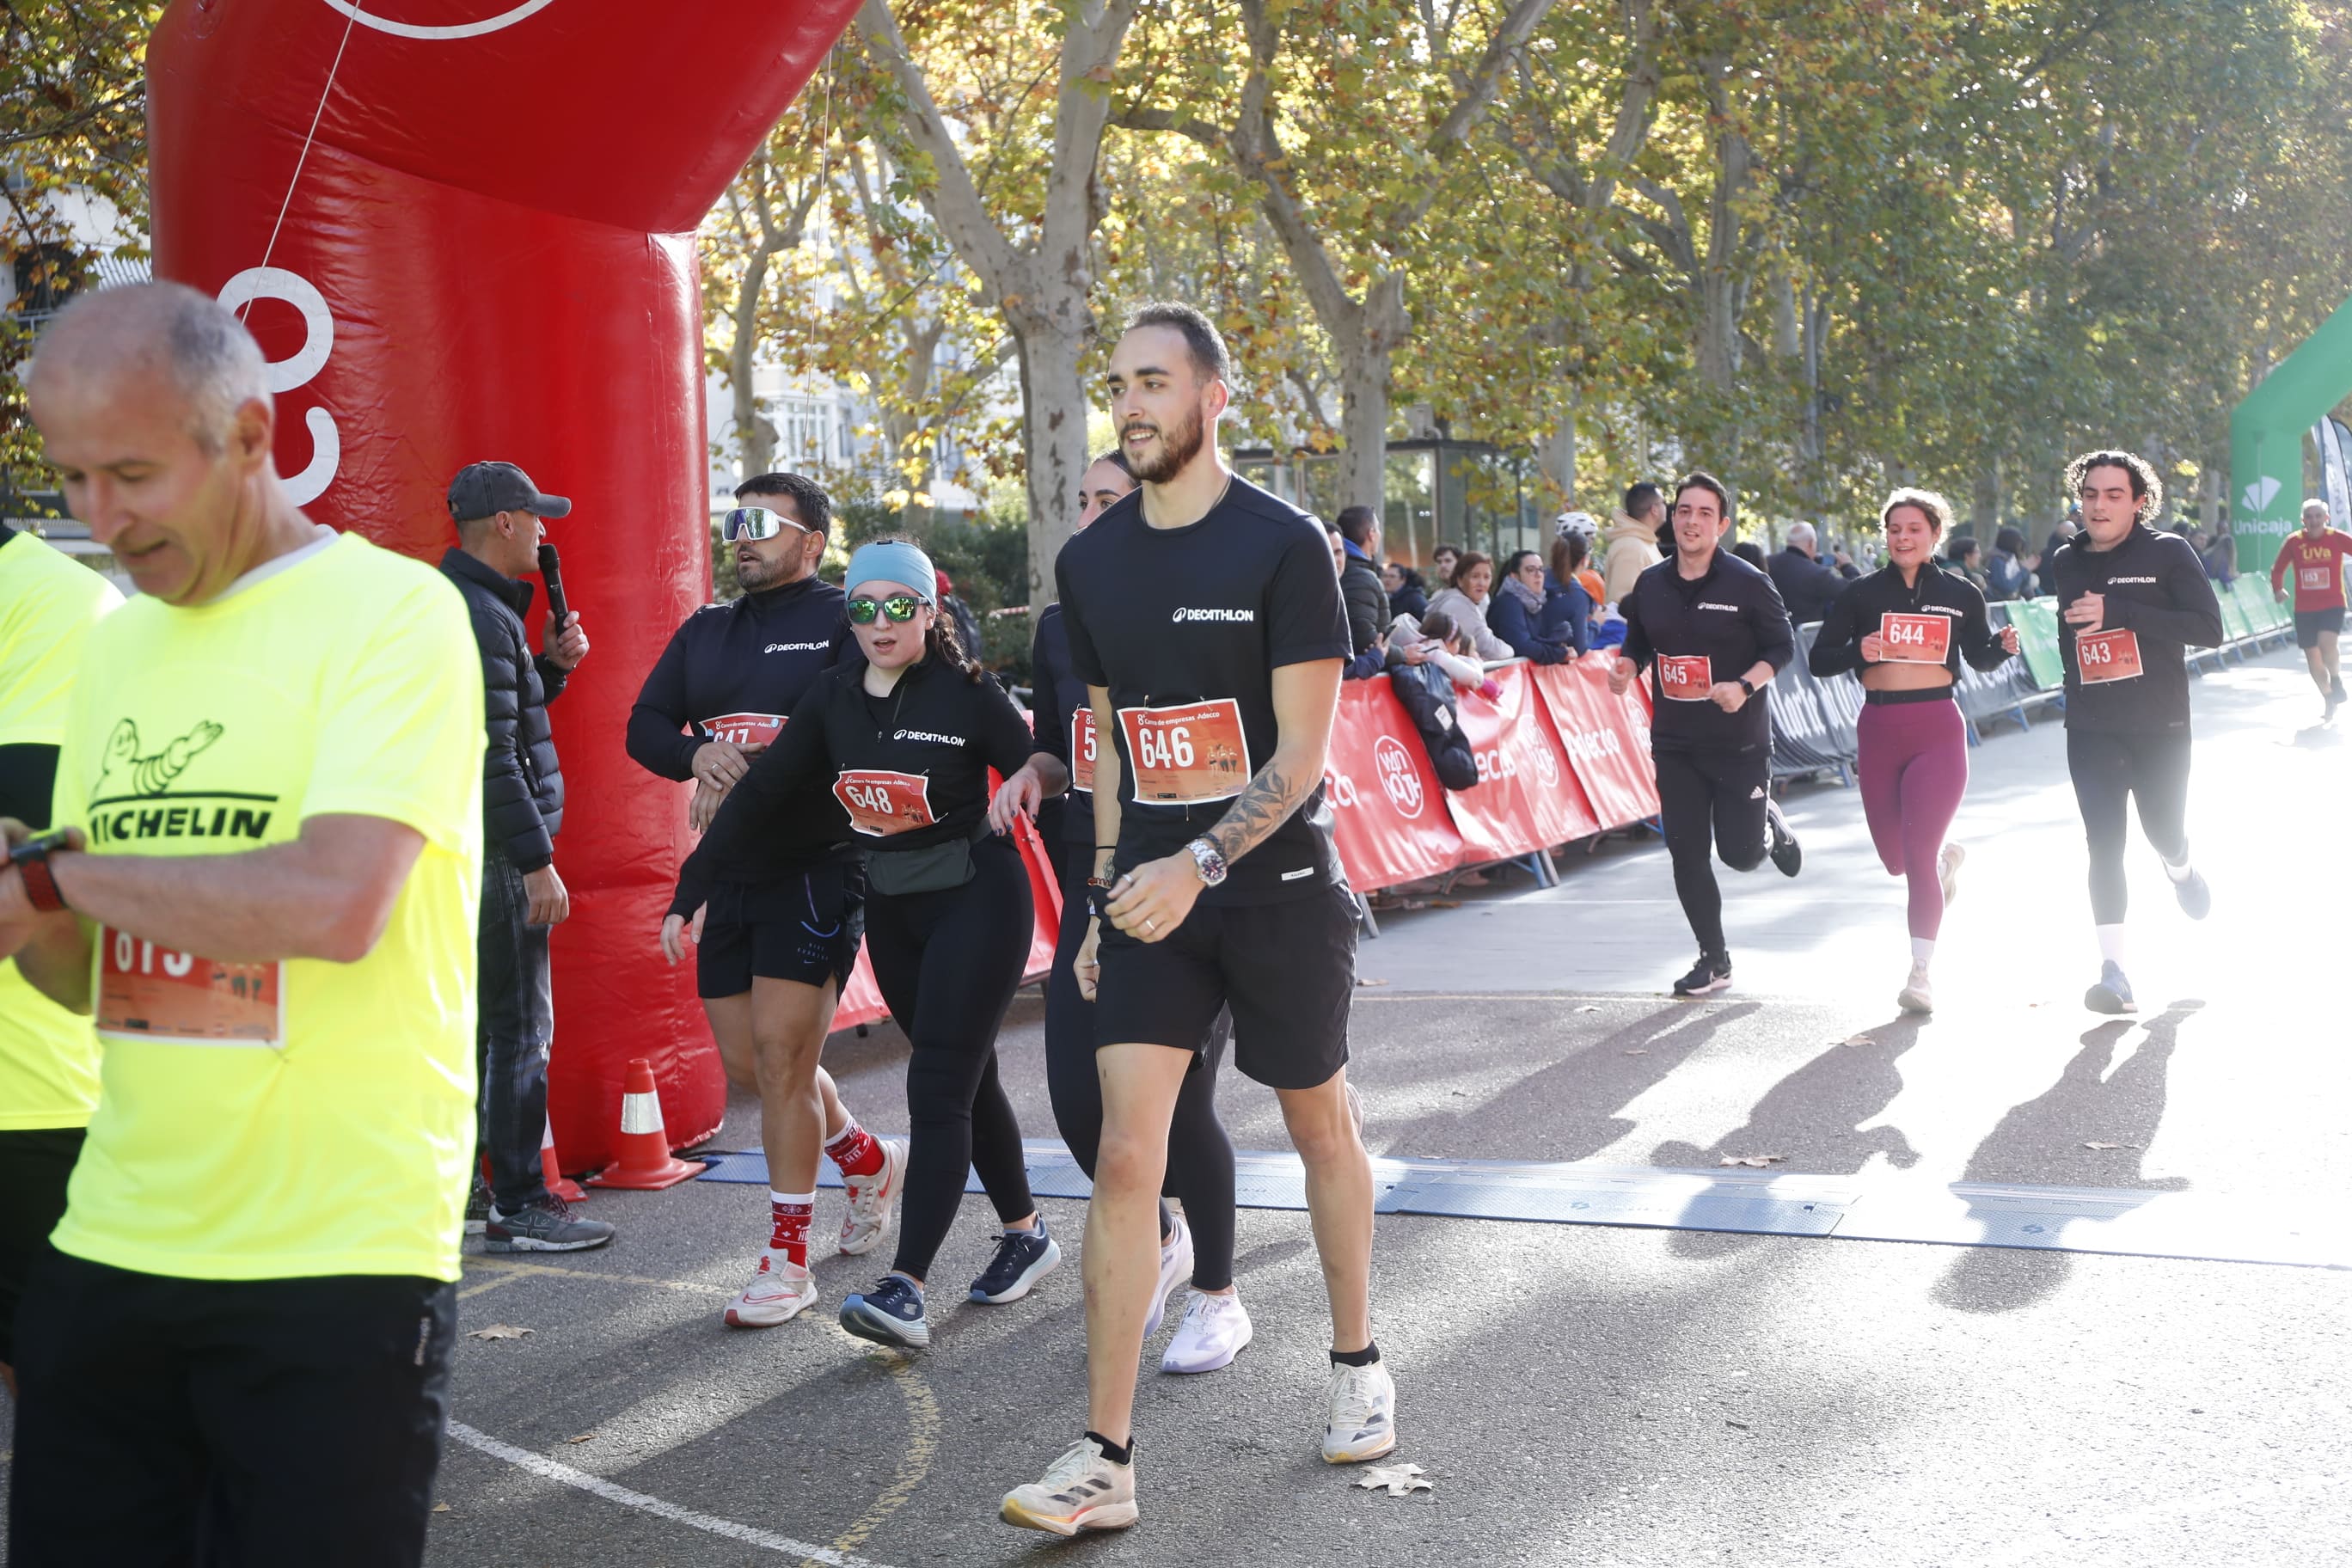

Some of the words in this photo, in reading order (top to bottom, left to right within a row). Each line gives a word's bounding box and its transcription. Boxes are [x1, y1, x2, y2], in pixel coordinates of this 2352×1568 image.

[2233, 518, 2293, 537] Unicaja
[1187, 609, 1254, 622] DECATHLON
[1890, 623, 1925, 645] 644
[777, 640, 830, 652] DECATHLON
[2081, 641, 2111, 665] 643
[1663, 664, 1687, 684] 645
[1166, 715, 1196, 726] empresas
[1197, 712, 1220, 720] Adecco
[907, 731, 966, 747] DECATHLON
[1139, 726, 1195, 769] 646
[1473, 747, 1517, 782] ecco
[845, 785, 893, 814] 648
